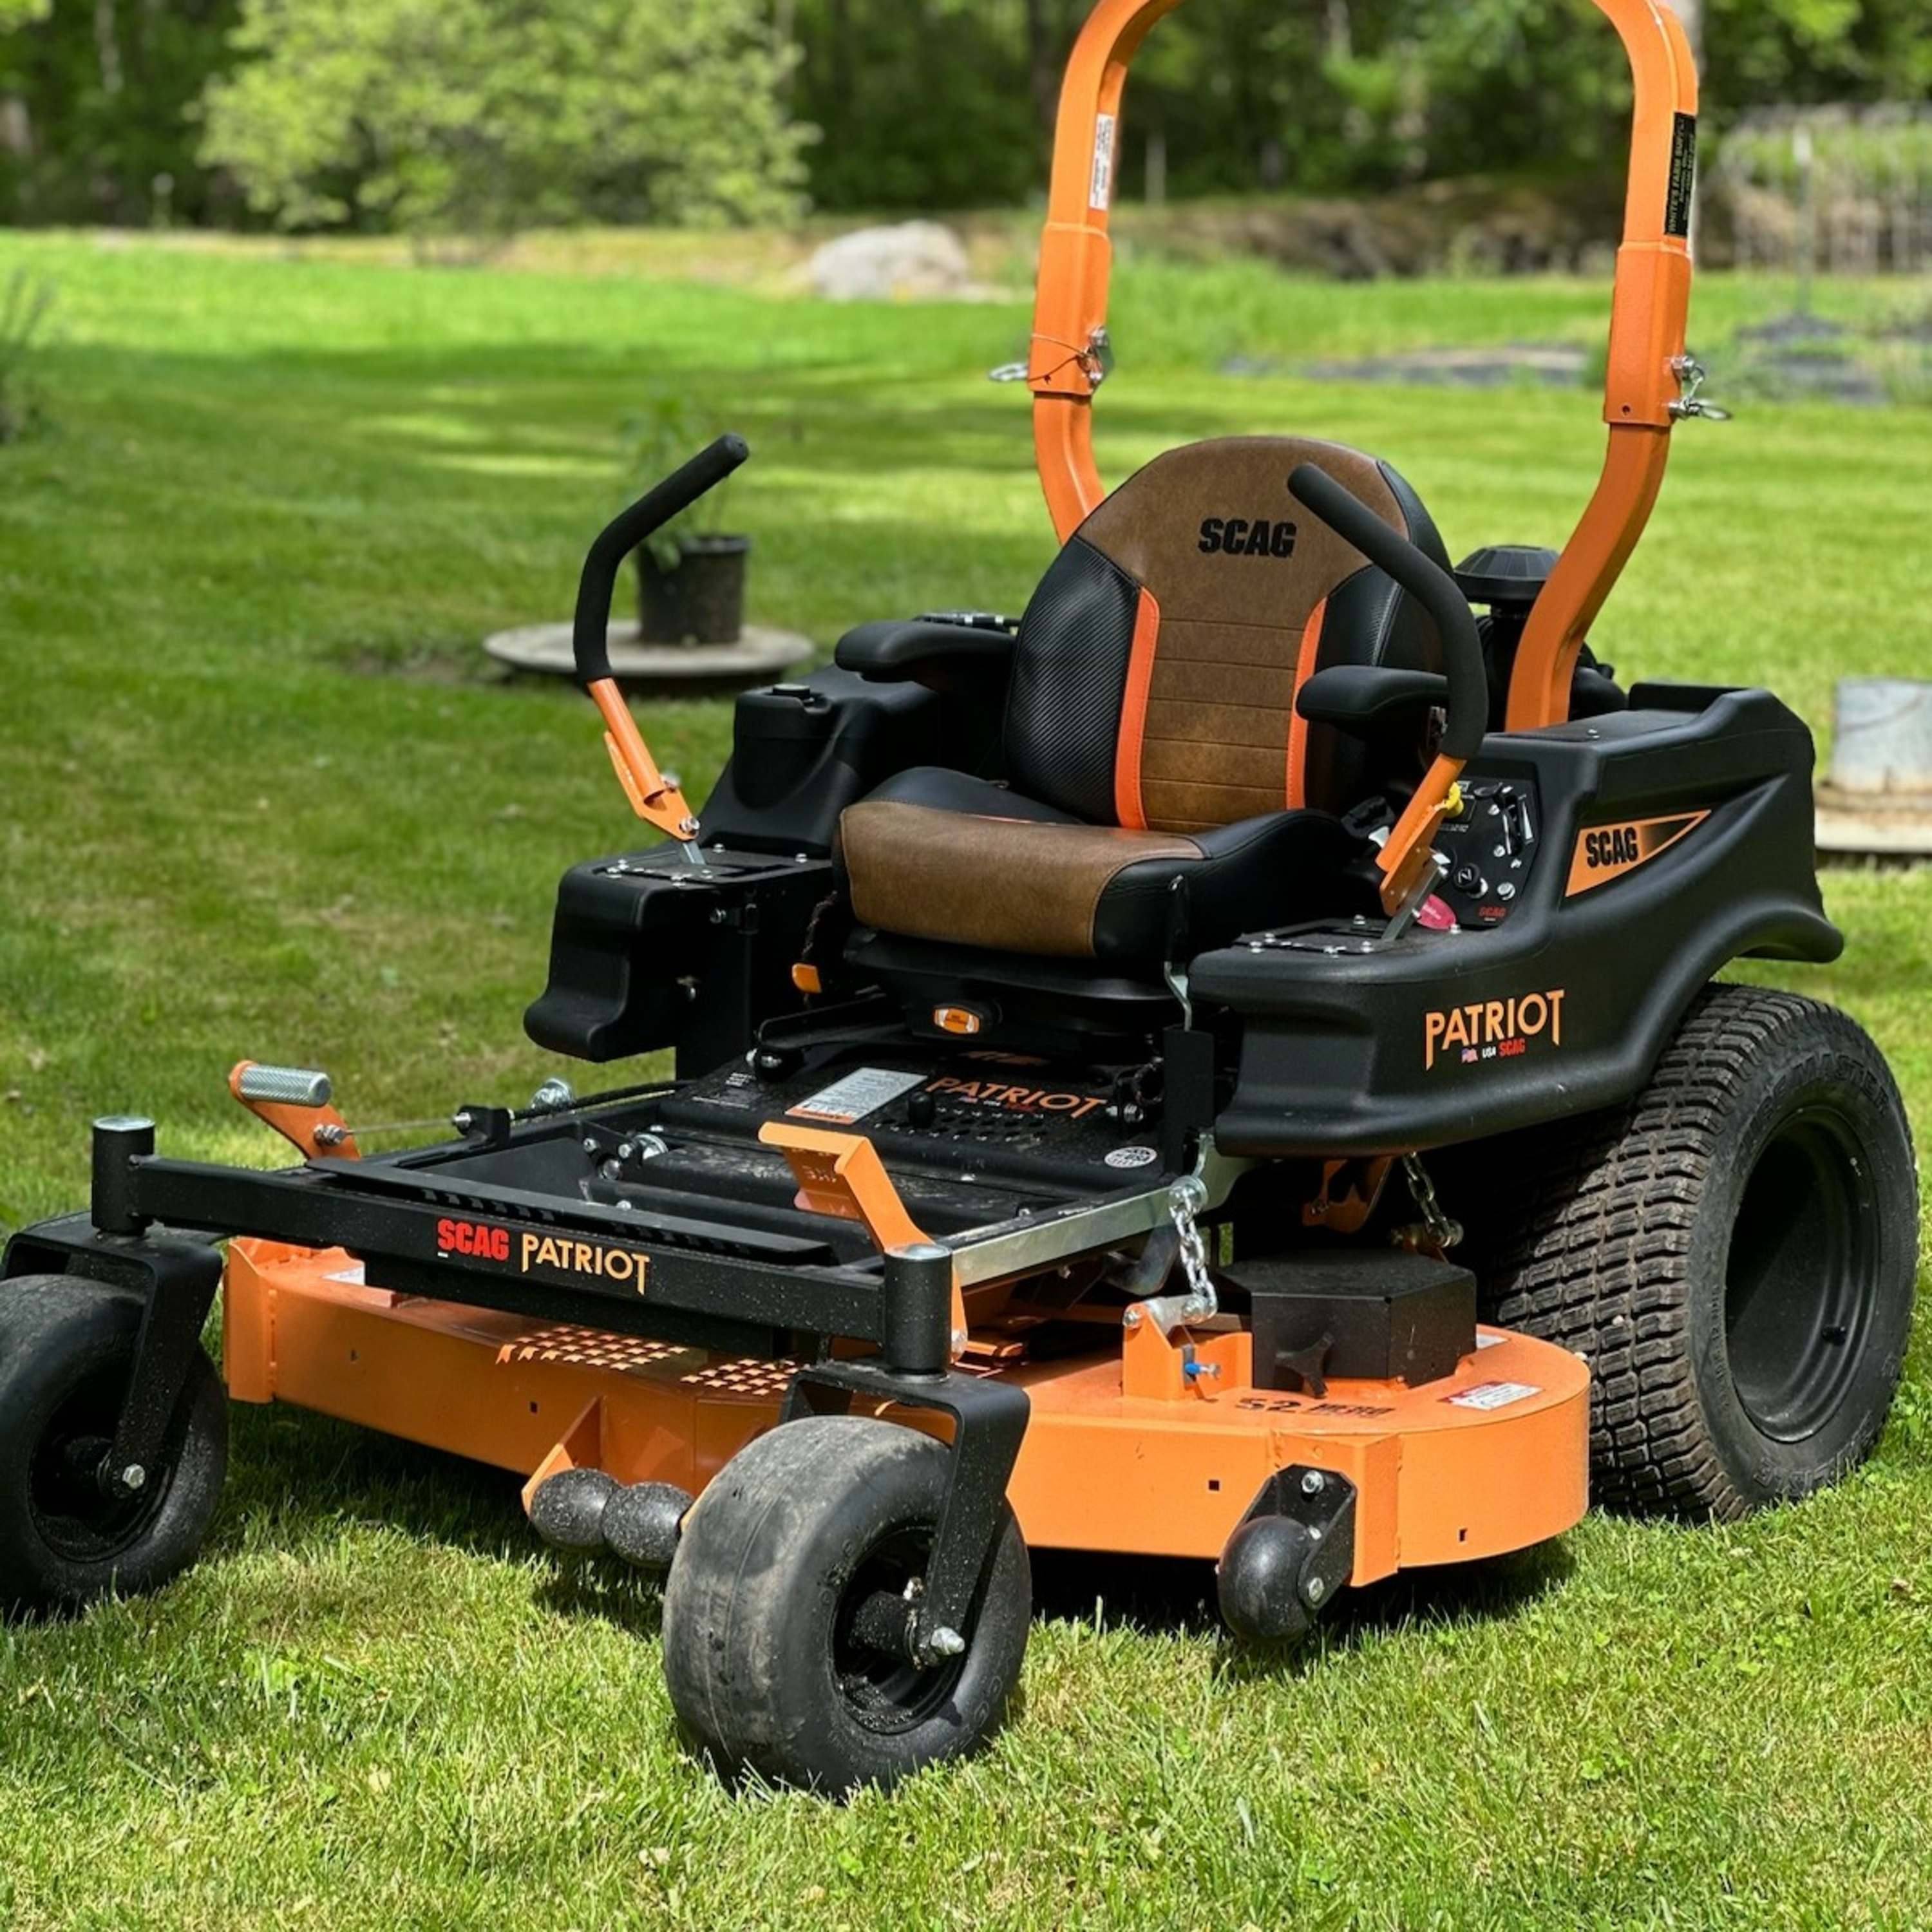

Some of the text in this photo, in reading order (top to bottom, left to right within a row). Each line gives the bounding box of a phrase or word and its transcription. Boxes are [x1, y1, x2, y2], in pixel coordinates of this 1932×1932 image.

[1672, 158, 1682, 188] FARM
[1197, 518, 1297, 558] SCAG
[1585, 827, 1639, 869] SCAG
[1425, 989, 1565, 1071] PATRIOT
[1482, 1037, 1526, 1059] USA SCAG
[925, 1077, 1108, 1118] PATRIOT
[1791, 1052, 1890, 1117] MASTER
[437, 1218, 650, 1295] SCAG PATRIOT
[1235, 1397, 1302, 1414] 52
